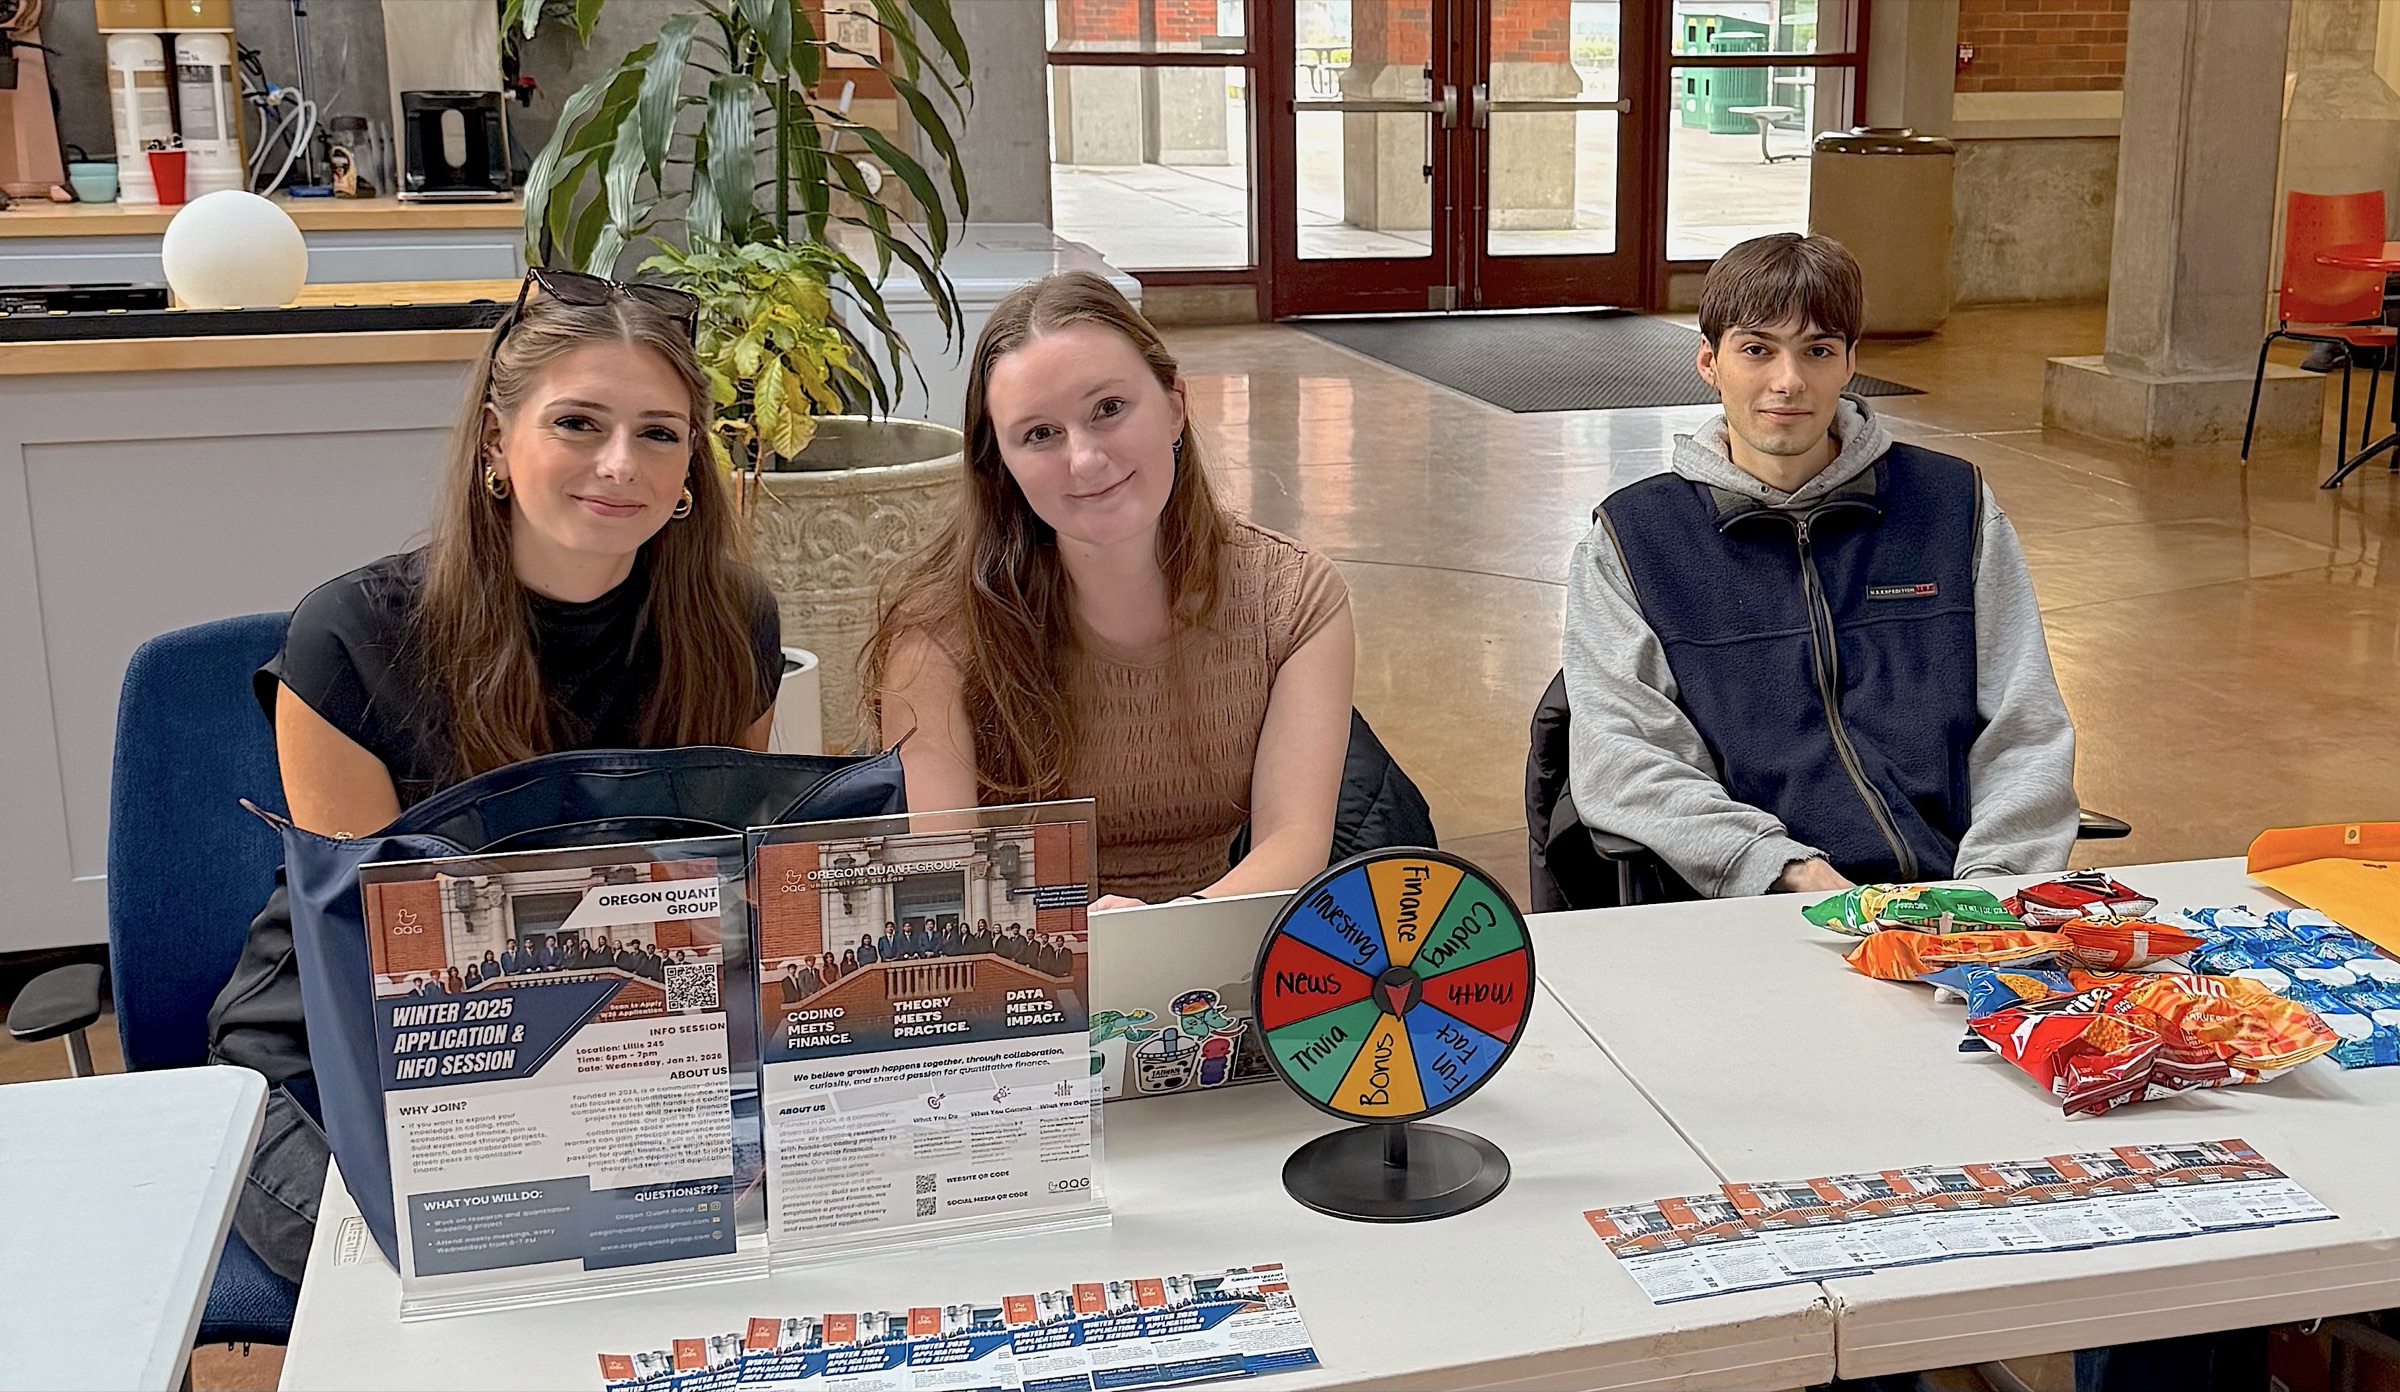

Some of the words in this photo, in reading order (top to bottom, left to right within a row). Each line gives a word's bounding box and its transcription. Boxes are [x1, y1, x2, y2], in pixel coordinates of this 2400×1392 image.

[807, 867, 864, 880] OREGON
[867, 863, 913, 876] QUANT
[916, 860, 961, 872] GROUP
[781, 884, 806, 892] OQG
[599, 892, 662, 906] OREGON
[665, 888, 717, 902] QUANT
[1397, 864, 1430, 942] Finance
[667, 902, 718, 914] GROUP
[1307, 888, 1379, 966] Investing
[1420, 901, 1498, 969] Coding
[1007, 989, 1043, 1000] DATA
[893, 997, 951, 1012] THEORY
[1007, 1001, 1053, 1014] MEETS
[393, 1003, 460, 1027] WINTER
[787, 1008, 845, 1022] CODING
[894, 1011, 942, 1025] MEETS
[1007, 1012, 1064, 1026] IMPACT.
[650, 1027, 676, 1036] INFO
[679, 1023, 725, 1033] SESSION
[788, 1021, 835, 1035] MEETS
[895, 1021, 969, 1038] PRACTICE.
[393, 1024, 508, 1054] APPLICATION
[511, 1025, 525, 1043] &
[788, 1033, 852, 1049] FINANCE.
[1437, 1023, 1478, 1064] Fact
[577, 1045, 620, 1055] Location:
[1289, 1025, 1349, 1071] Trivia
[396, 1057, 437, 1080] INFO
[441, 1050, 516, 1075] SESSION
[577, 1055, 603, 1063] Time:
[578, 1065, 602, 1073] Date:
[606, 1059, 664, 1070] Wednesday,
[794, 1074, 808, 1082] We
[811, 1071, 844, 1080] believe
[847, 1067, 879, 1077] growth
[882, 1063, 920, 1072] happens
[923, 1058, 964, 1068] together,
[966, 1054, 1001, 1064] through
[1004, 1048, 1064, 1059] collaboration,
[670, 1069, 709, 1080] ABOUT
[713, 1067, 727, 1075] US
[854, 1077, 872, 1085] and
[874, 1074, 905, 1083] shared
[907, 1068, 941, 1081] passion
[944, 1066, 960, 1076] for
[960, 1062, 1012, 1075] quantitative
[1015, 1059, 1050, 1068] finance.
[1151, 1067, 1180, 1078] TAIWAN
[1360, 1032, 1394, 1105] Bonus
[1431, 1051, 1469, 1093] Fun
[399, 1106, 429, 1116] WHY
[432, 1101, 467, 1113] JOIN?
[779, 1106, 811, 1115] ABOUT
[947, 1174, 977, 1183] WEBSITE
[1059, 1178, 1090, 1190] OQG
[635, 1184, 719, 1202] QUESTIONS???
[424, 1199, 461, 1211] WHAT
[464, 1196, 489, 1206] YOU
[492, 1192, 520, 1204] WILL
[521, 1190, 543, 1200] DO:
[1146, 1318, 1198, 1329] APPLICATION
[826, 1356, 882, 1367] APPLICATION
[827, 1350, 860, 1359] WINTER
